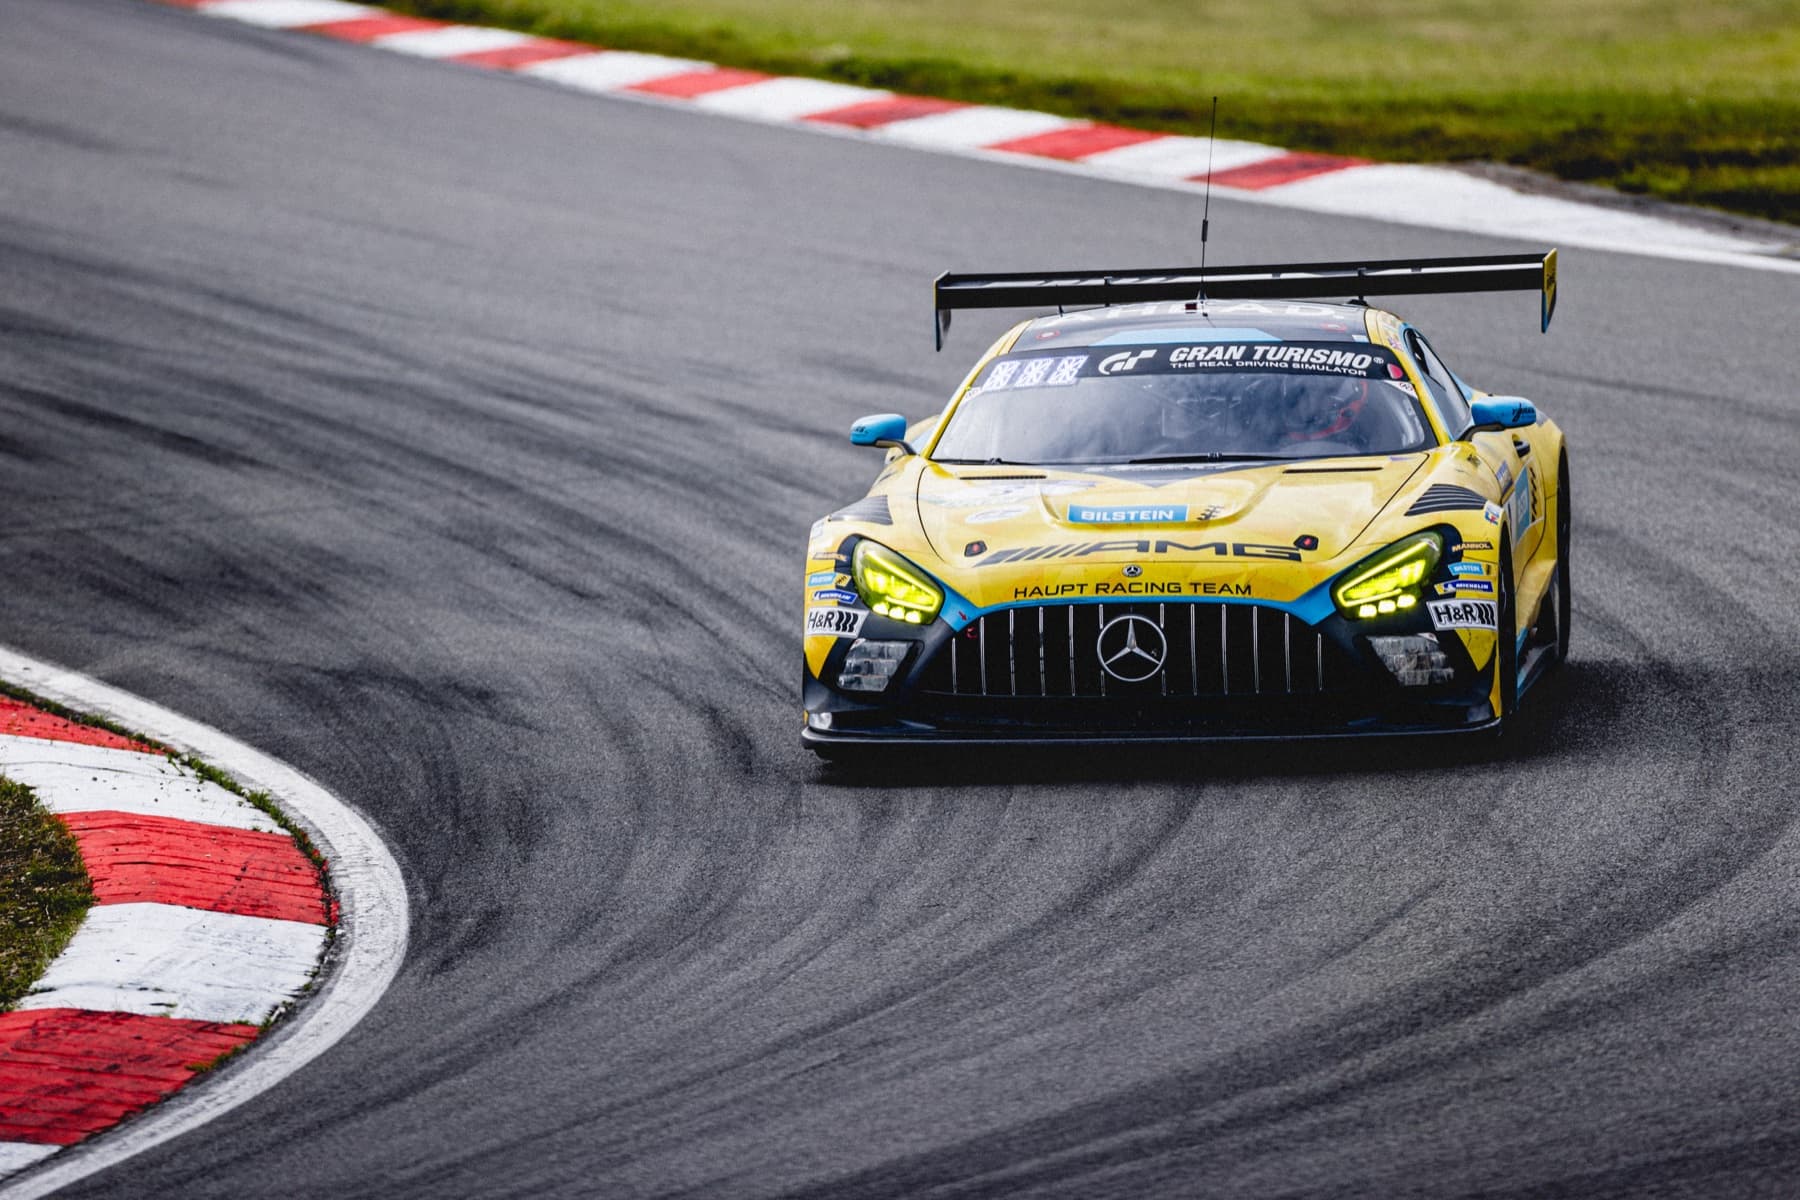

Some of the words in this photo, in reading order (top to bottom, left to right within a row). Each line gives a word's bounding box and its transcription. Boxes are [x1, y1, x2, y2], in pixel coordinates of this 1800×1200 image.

[1169, 346, 1247, 363] GRAN
[1236, 361, 1289, 369] DRIVING
[1292, 363, 1367, 376] SIMULATOR
[1081, 508, 1174, 522] BILSTEIN
[1076, 540, 1302, 562] AMG
[1014, 584, 1088, 599] HAUPT
[1096, 582, 1182, 595] RACING
[1190, 582, 1252, 596] TEAM
[808, 610, 835, 629] H&R
[1433, 603, 1477, 623] H&R
